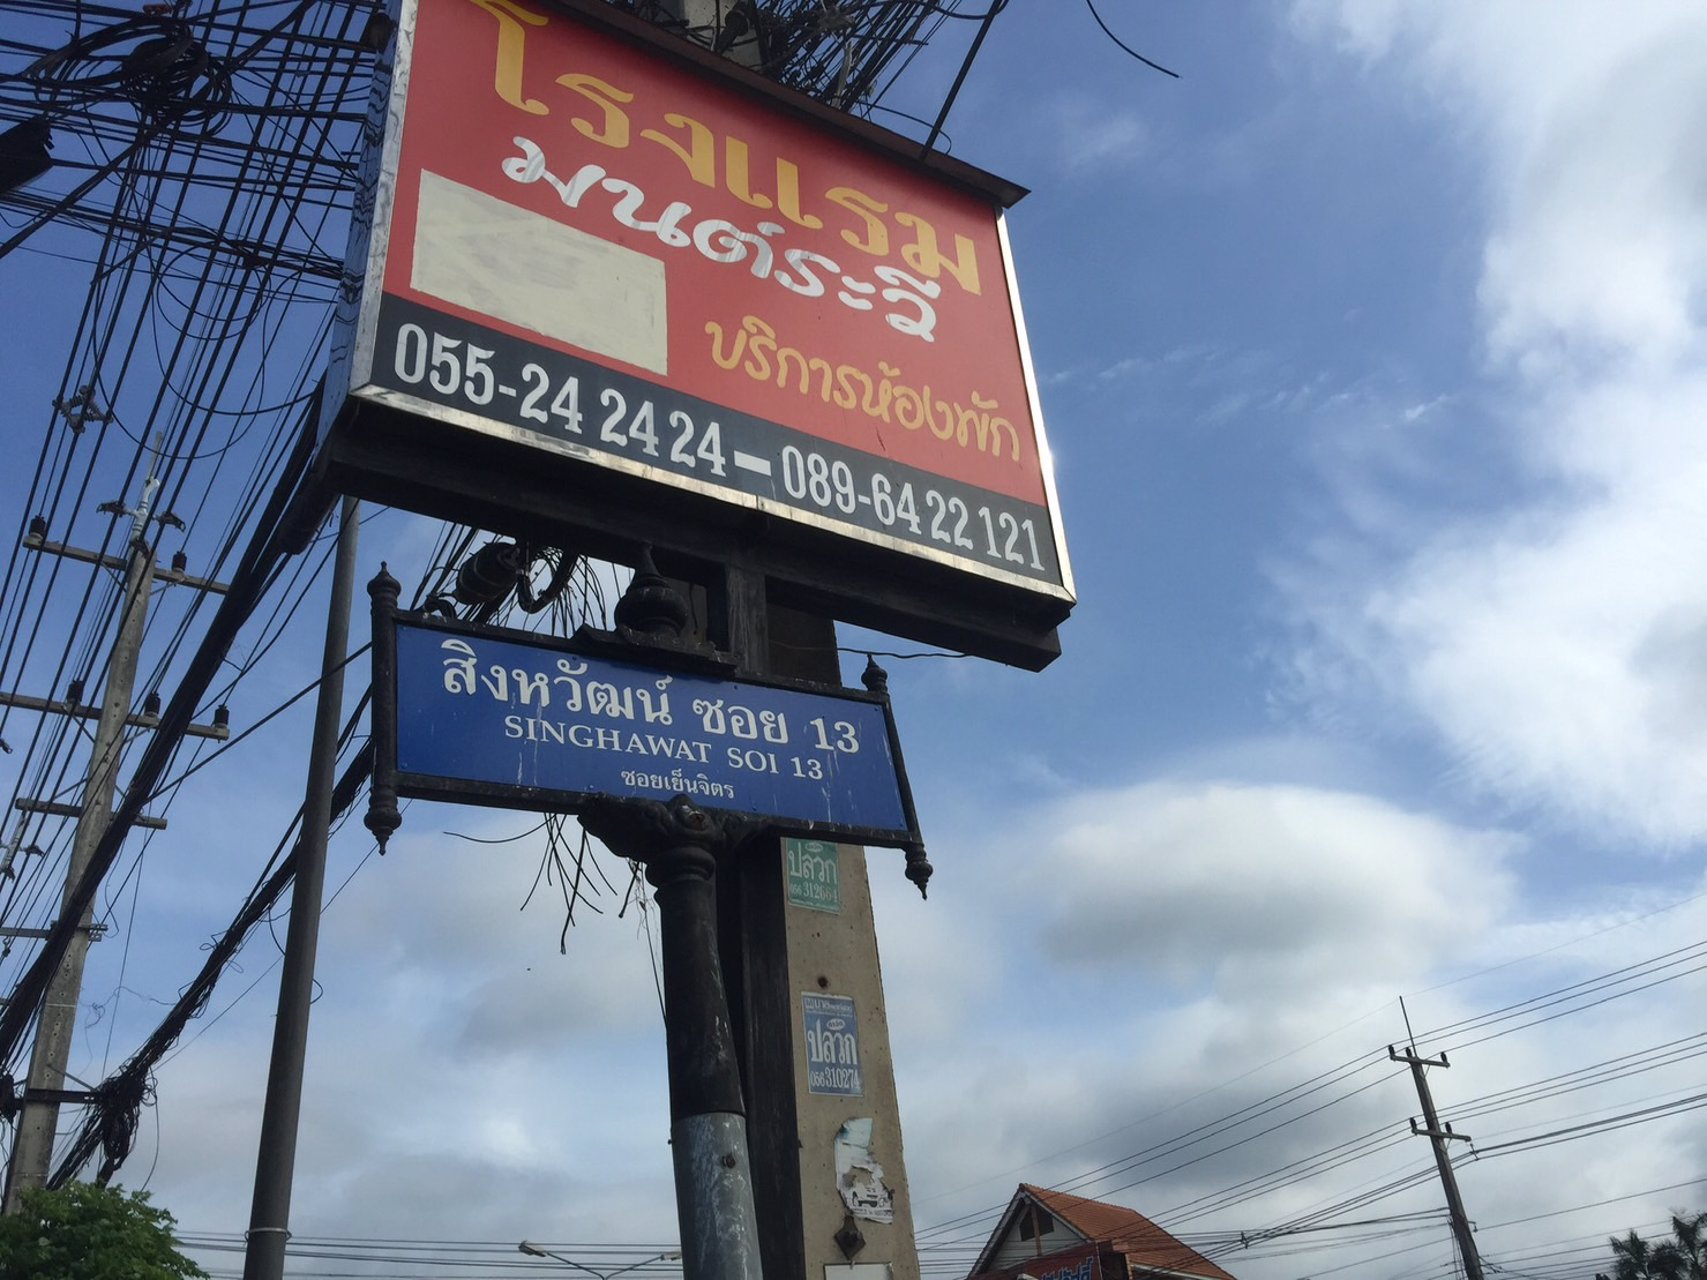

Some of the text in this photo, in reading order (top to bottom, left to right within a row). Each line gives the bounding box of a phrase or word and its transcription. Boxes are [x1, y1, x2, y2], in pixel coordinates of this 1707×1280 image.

[467, 0, 981, 295] โรงแรม
[705, 315, 1020, 461] บริการห้องพัก
[441, 639, 859, 753] สิงหวัฒน์ ซอย 13
[504, 715, 823, 780] SINGHAWAT SOI 13
[620, 768, 734, 799] ซอยเย็นจิตร
[788, 842, 837, 884] ปลวก
[807, 1019, 858, 1065] ปลวก
